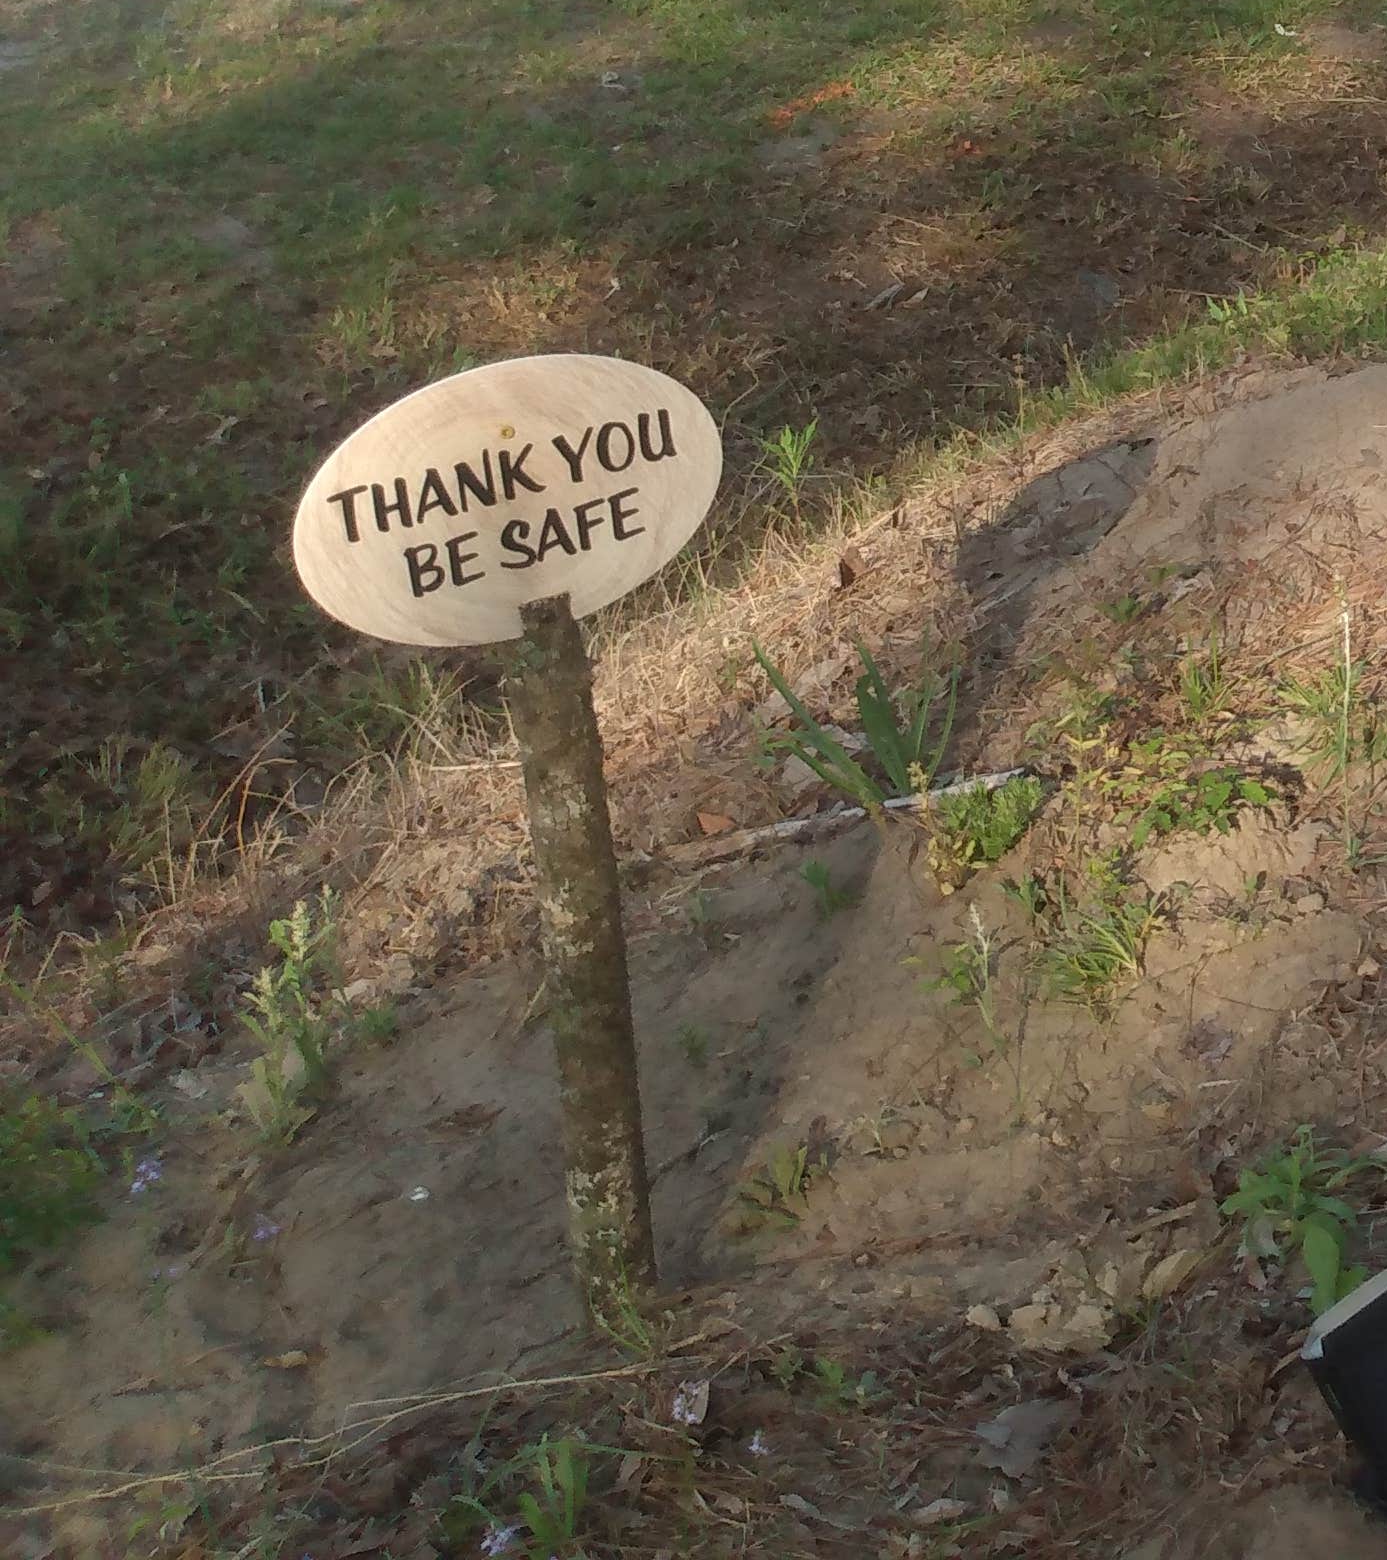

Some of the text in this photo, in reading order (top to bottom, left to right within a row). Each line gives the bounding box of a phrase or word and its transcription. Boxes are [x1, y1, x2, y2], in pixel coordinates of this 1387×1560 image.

[326, 408, 678, 544] THANK YOU
[403, 486, 646, 598] BE SAFE
